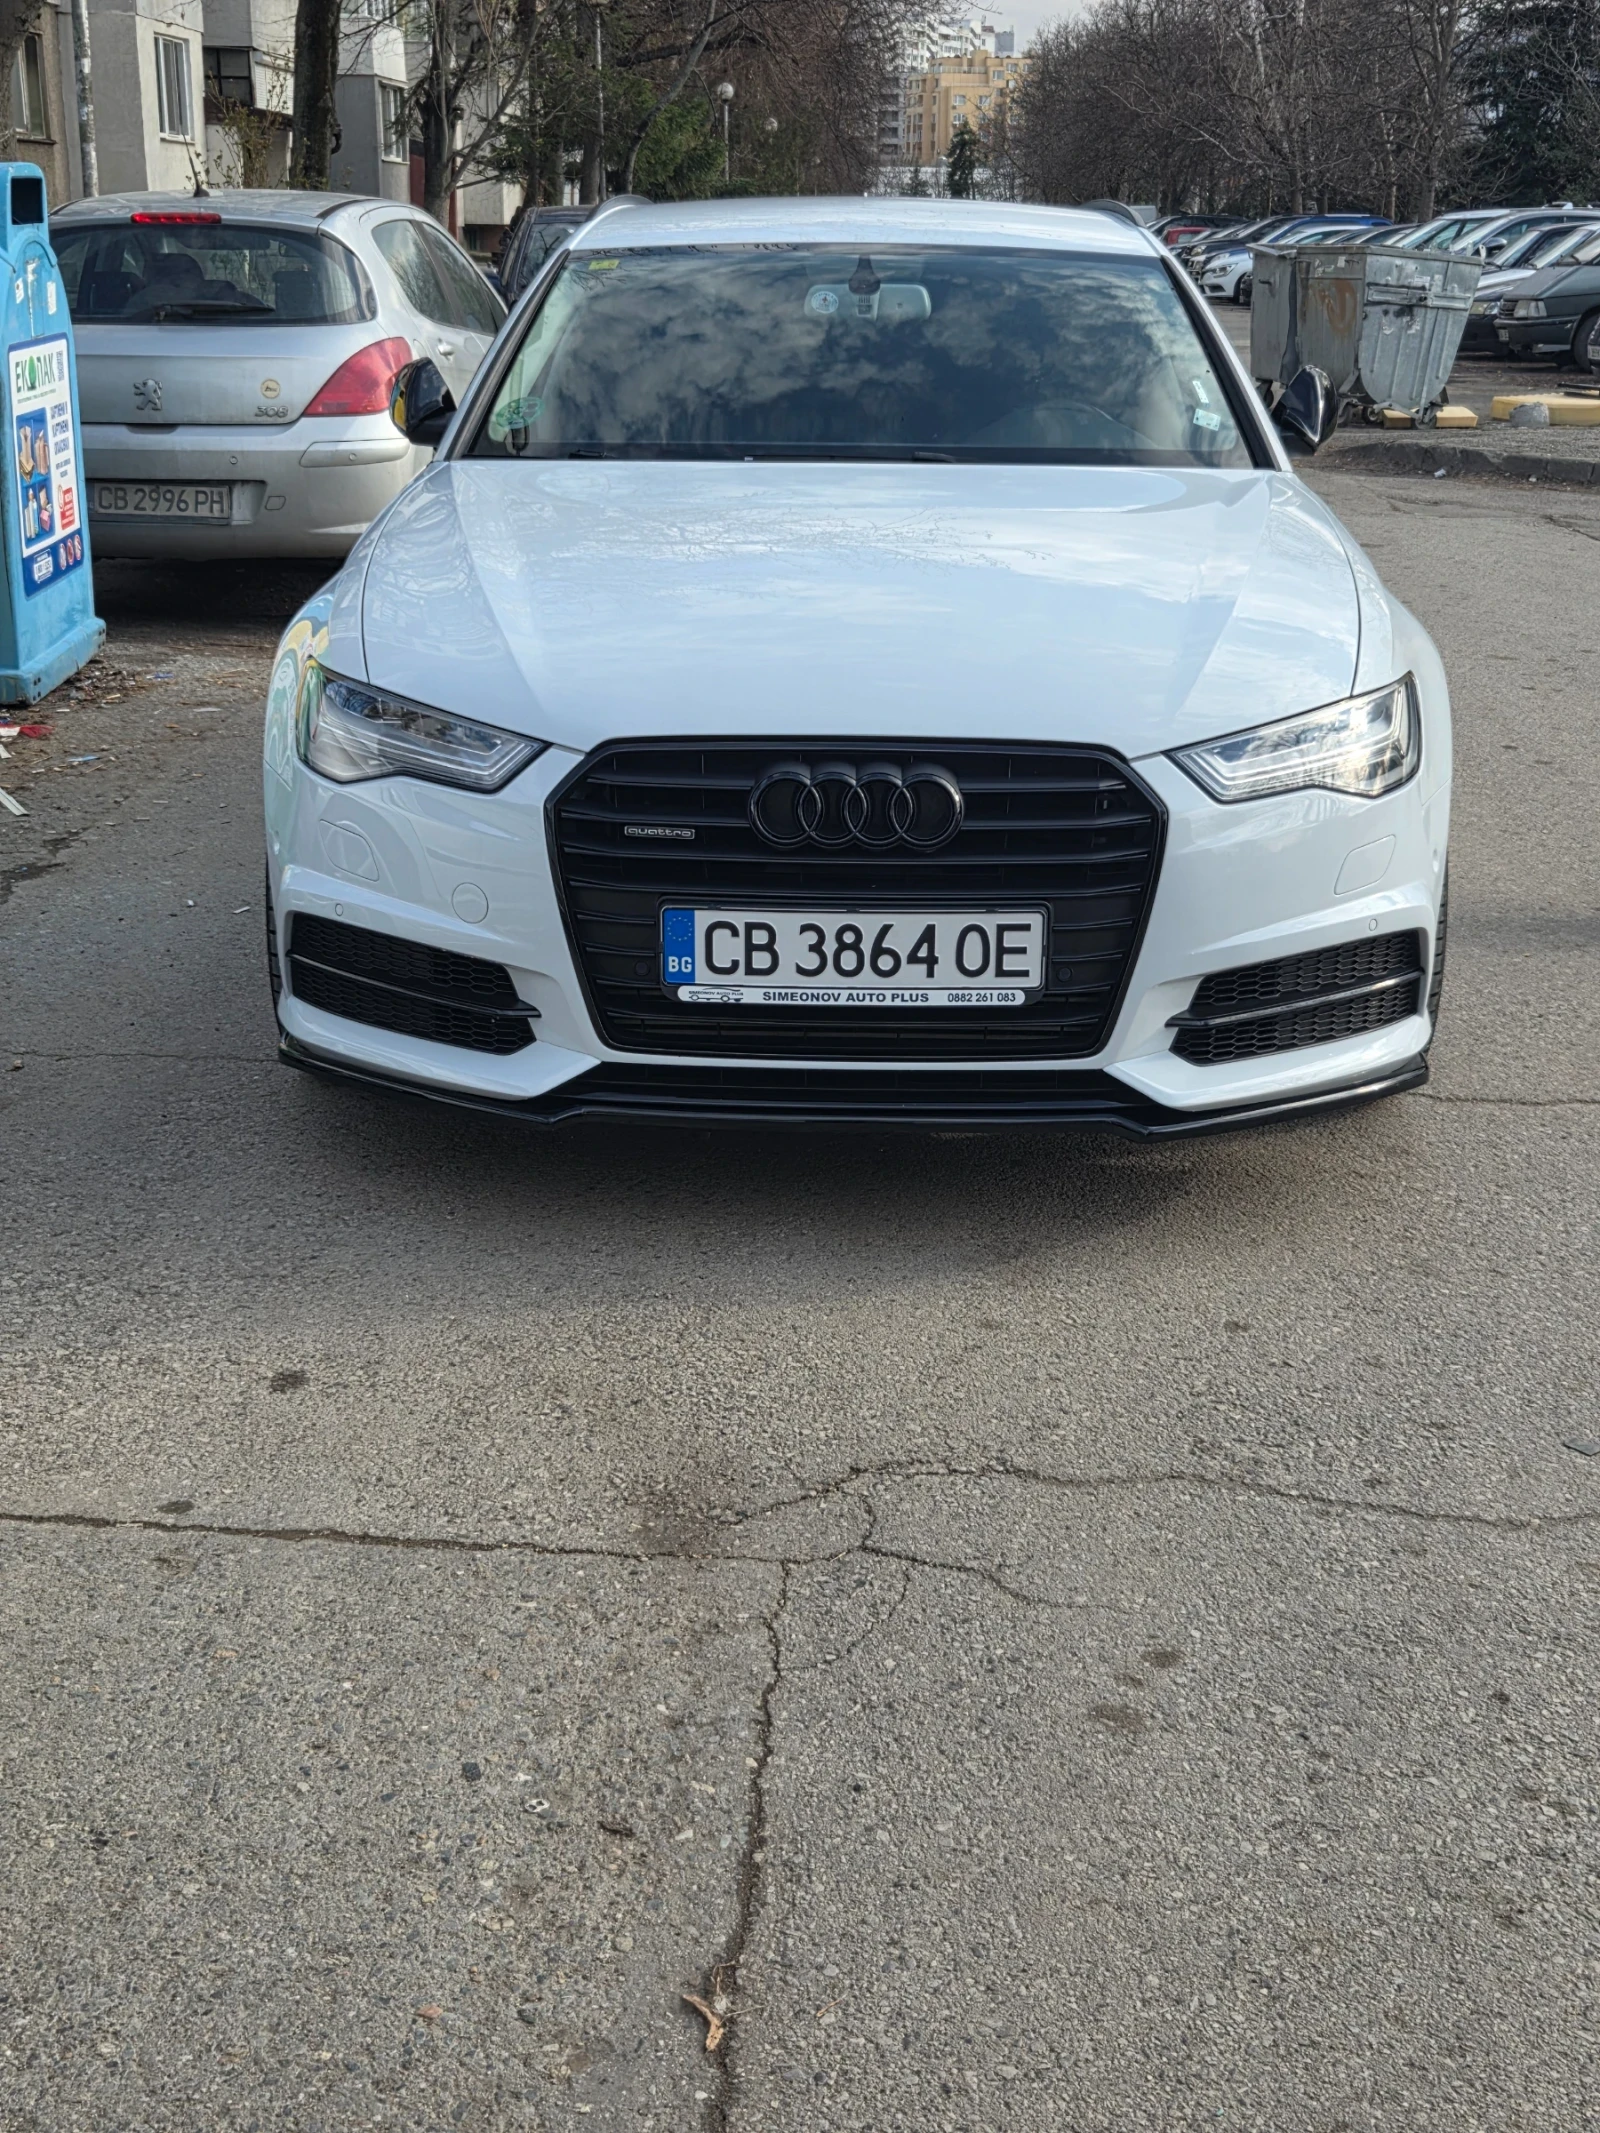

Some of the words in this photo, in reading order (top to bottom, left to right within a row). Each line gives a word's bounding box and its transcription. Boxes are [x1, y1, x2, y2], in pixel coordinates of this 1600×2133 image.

[255, 405, 288, 418] 308
[98, 486, 128, 511] CB
[133, 488, 189, 512] 2996
[194, 490, 224, 513] PH
[628, 827, 691, 836] quattro
[705, 920, 779, 976] CB
[795, 922, 939, 978] 3864
[955, 923, 1032, 978] OE
[668, 956, 692, 973] BG
[763, 991, 841, 1002] SIMEONOV
[846, 992, 886, 1002] AUTO
[891, 993, 929, 1003] PLUS
[948, 992, 973, 1003] 0882
[976, 993, 993, 1003] 261
[997, 993, 1016, 1003] 083
